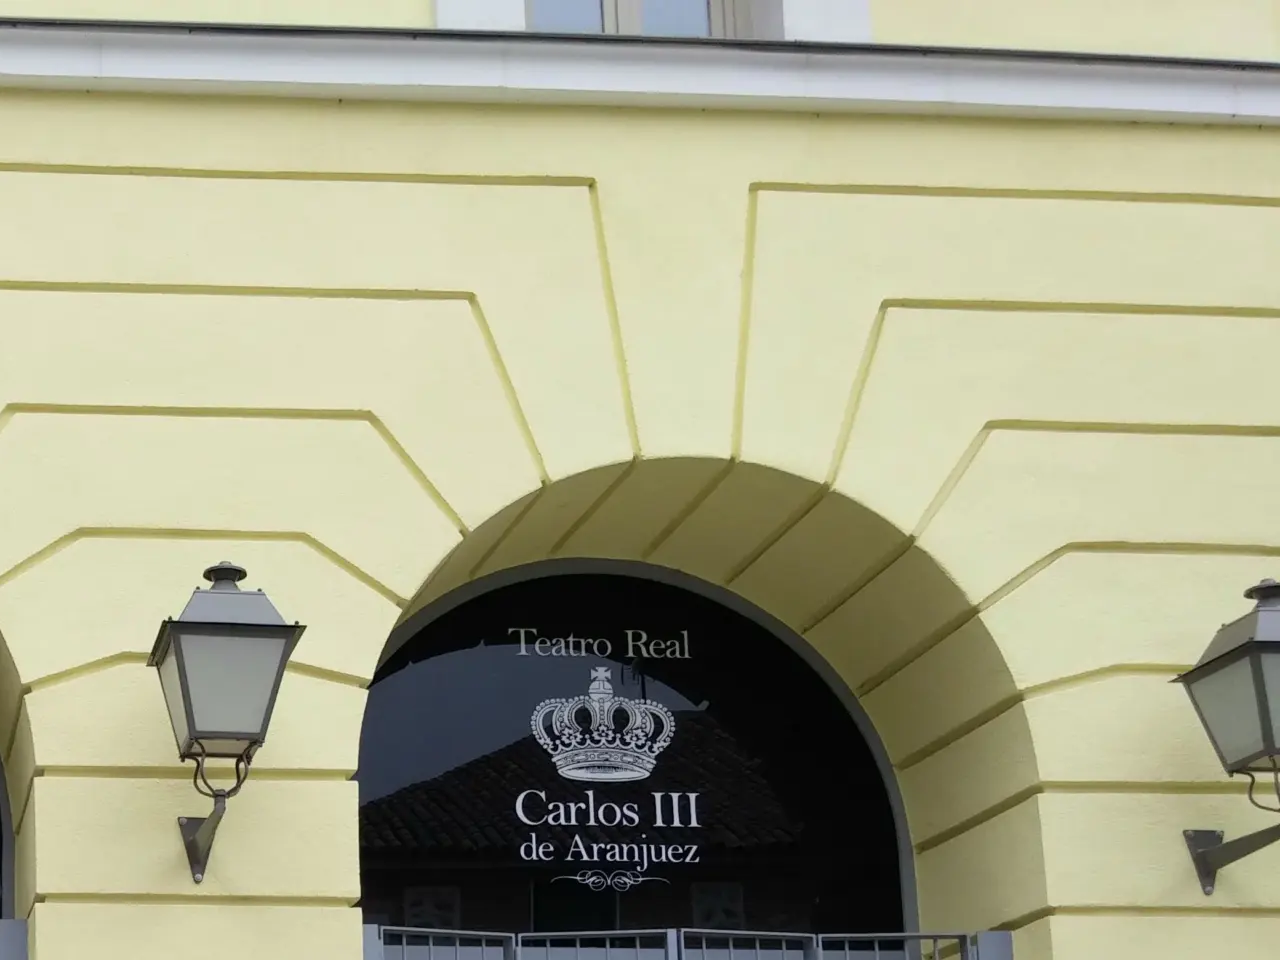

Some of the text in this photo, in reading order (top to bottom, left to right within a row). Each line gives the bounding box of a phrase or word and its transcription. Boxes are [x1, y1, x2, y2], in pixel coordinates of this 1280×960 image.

[508, 628, 692, 659] Teatro Real
[515, 790, 702, 828] Carlos III
[520, 833, 700, 872] de Aranjuez
